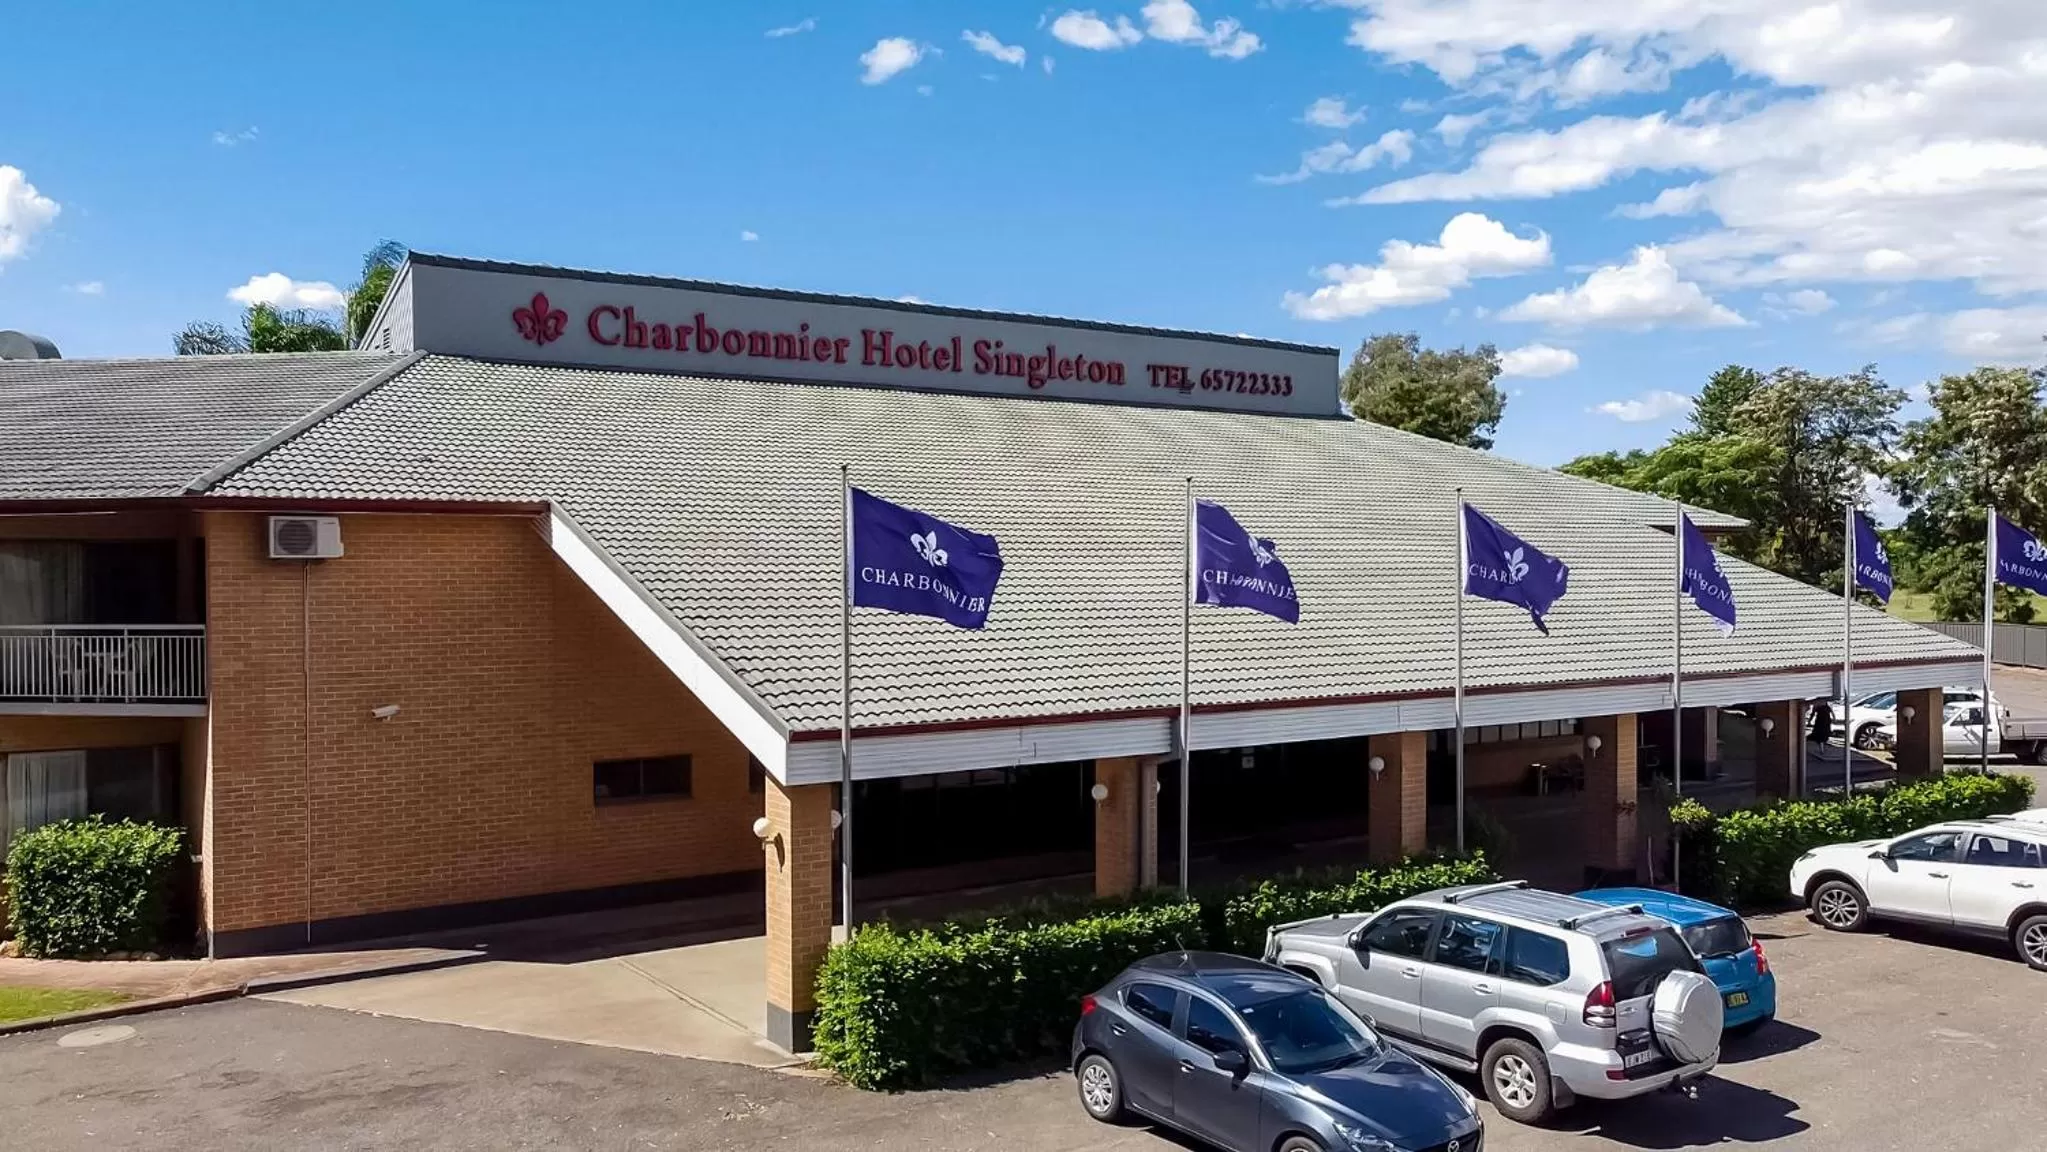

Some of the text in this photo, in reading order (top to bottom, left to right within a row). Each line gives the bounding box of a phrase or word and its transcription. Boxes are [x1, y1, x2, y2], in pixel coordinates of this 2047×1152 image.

[587, 304, 1293, 396] Charbonnier Hotel Singleton TEL 65722333
[861, 567, 986, 613] CHARBONNIER
